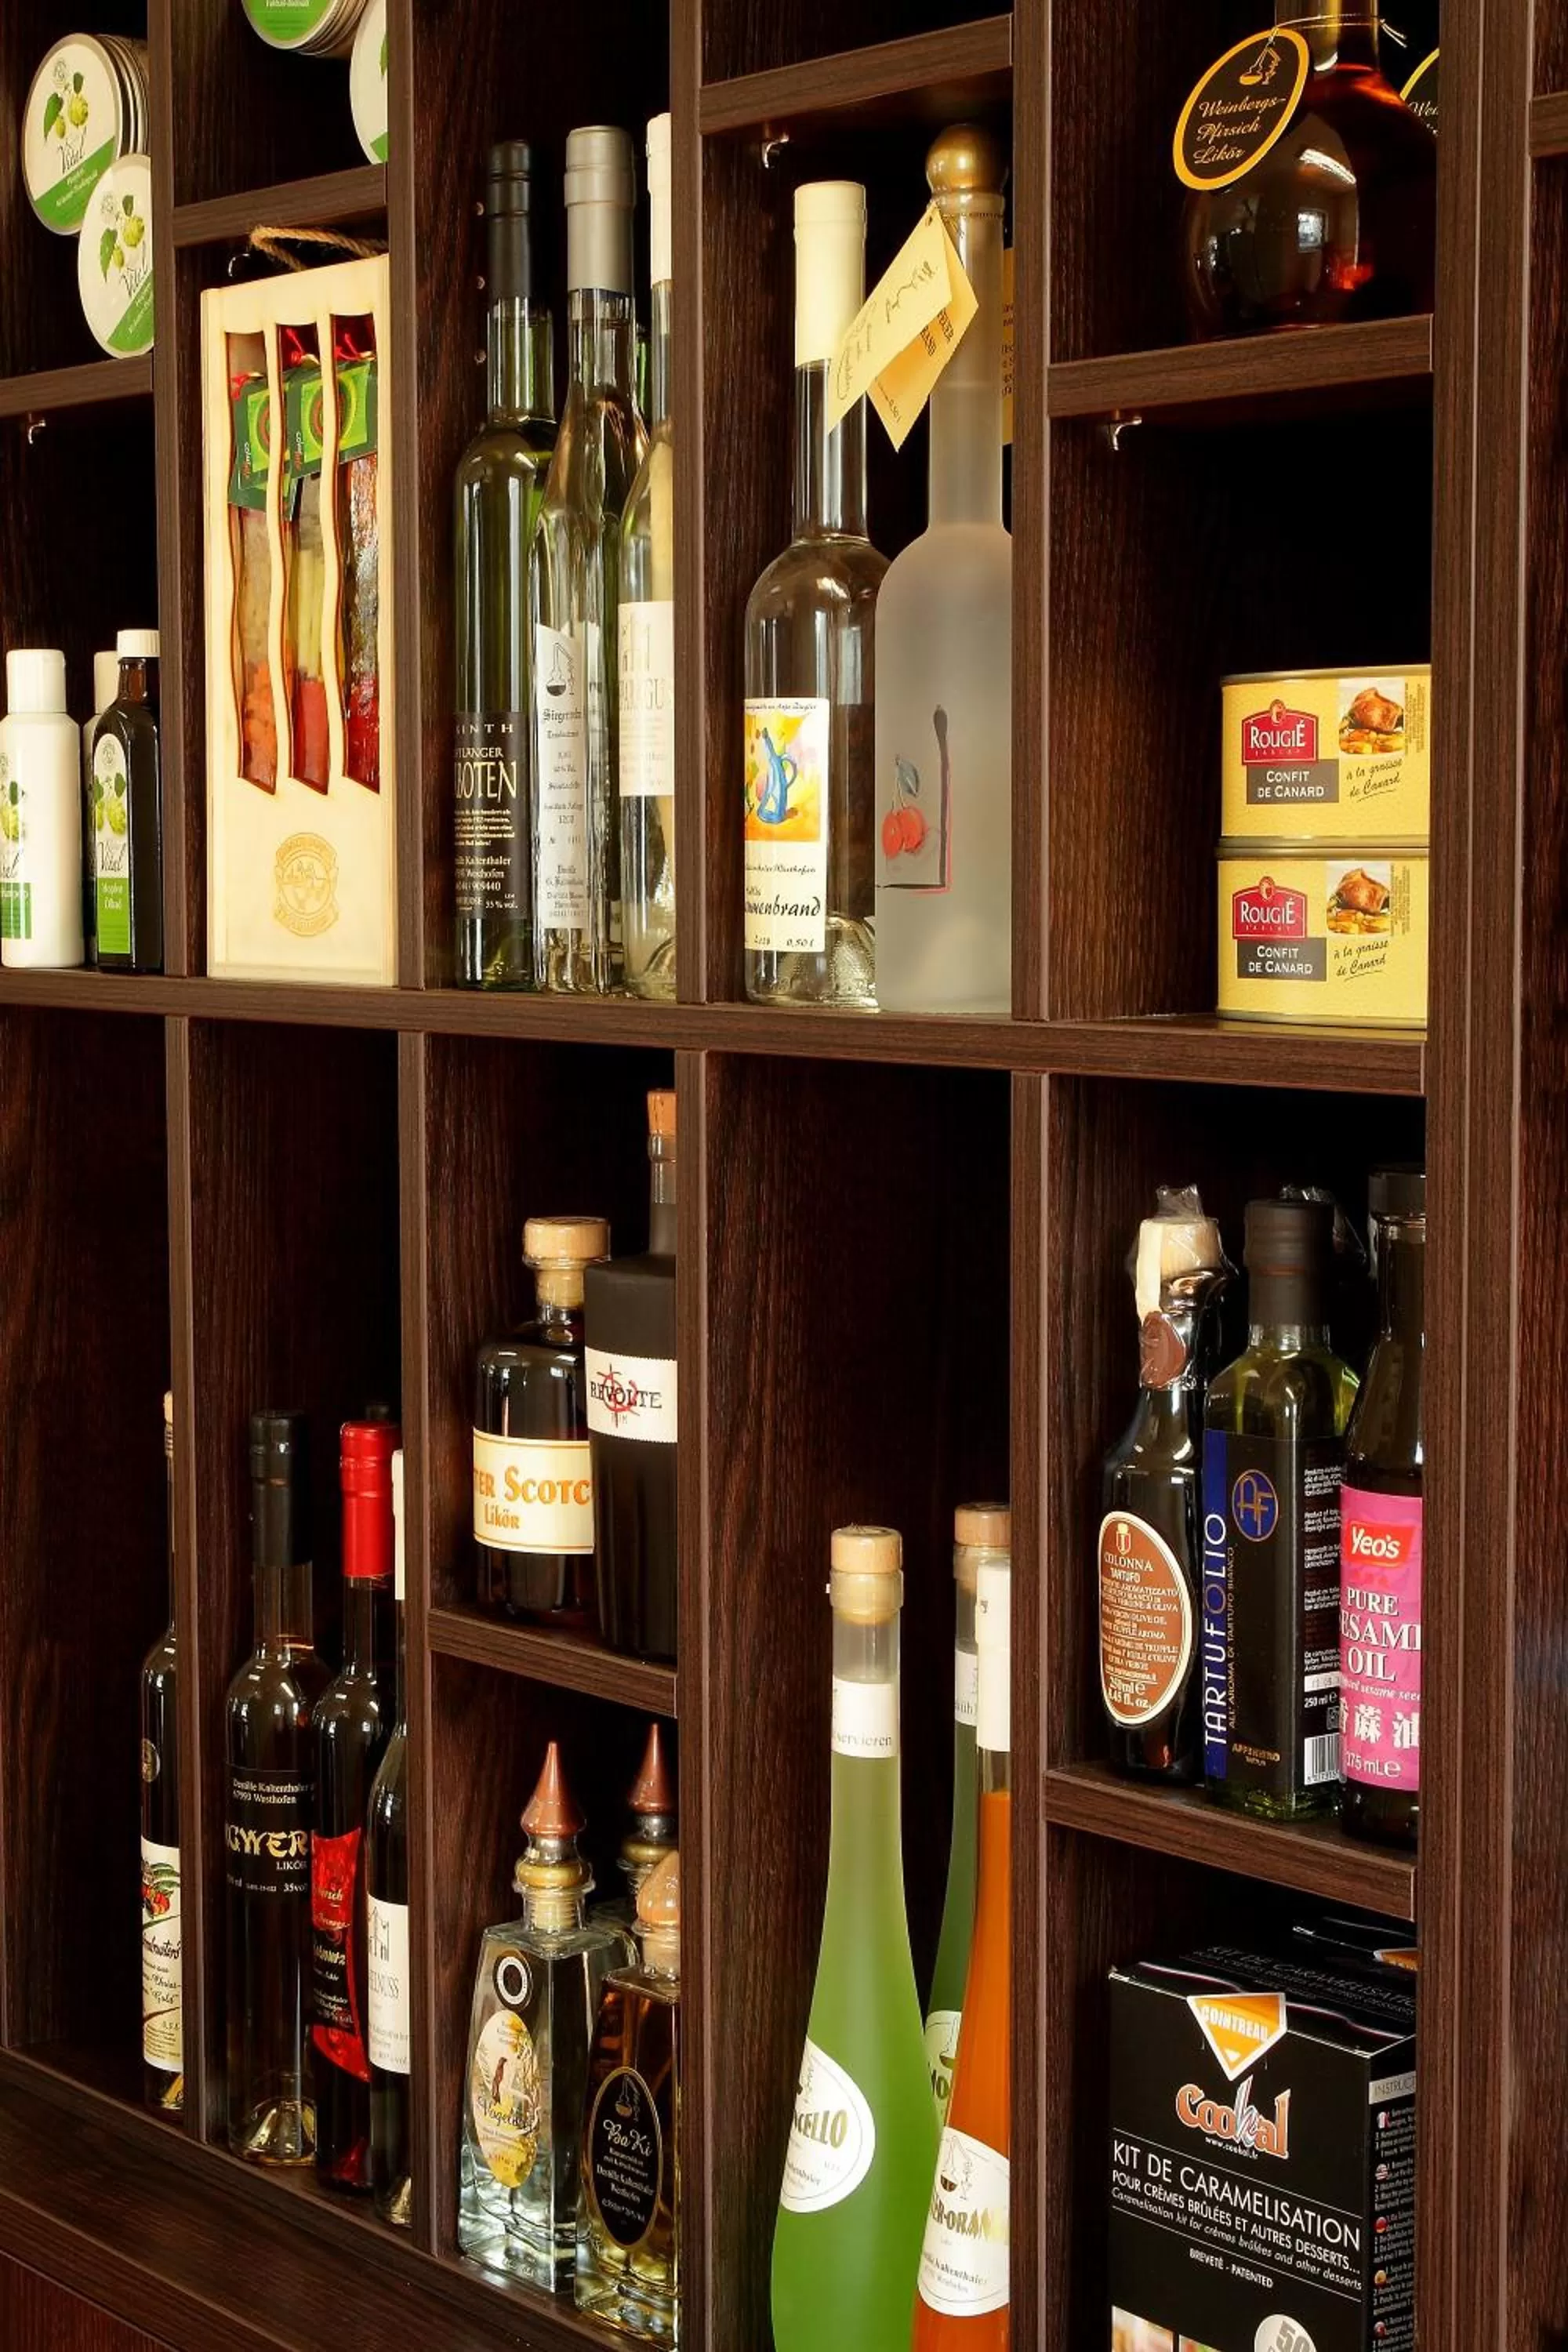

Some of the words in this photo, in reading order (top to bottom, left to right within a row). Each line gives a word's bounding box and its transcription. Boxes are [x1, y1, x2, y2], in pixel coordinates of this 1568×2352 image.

[1199, 96, 1287, 118] Weinbergs-
[1196, 116, 1261, 144] Pfirsich
[1193, 144, 1246, 164] Likör
[1351, 1526, 1401, 1559] Yeo's
[1347, 1586, 1399, 1617] PURE
[1205, 1514, 1227, 1745] TARTUFOLIO
[1348, 1646, 1396, 1682] OIL
[1201, 2004, 1269, 2042] COINTREAU
[1112, 2169, 1142, 2193] POUR
[1235, 2216, 1248, 2233] ET
[1250, 2223, 1293, 2249] AUTRES
[1113, 2139, 1141, 2169] KIT
[1147, 2153, 1172, 2183] DE
[1180, 2166, 1360, 2252] CARAMELISATION
[1189, 2216, 1203, 2230] for
[1274, 2252, 1294, 2265] and
[1295, 2259, 1321, 2274] other
[1323, 2267, 1363, 2291] desserts
